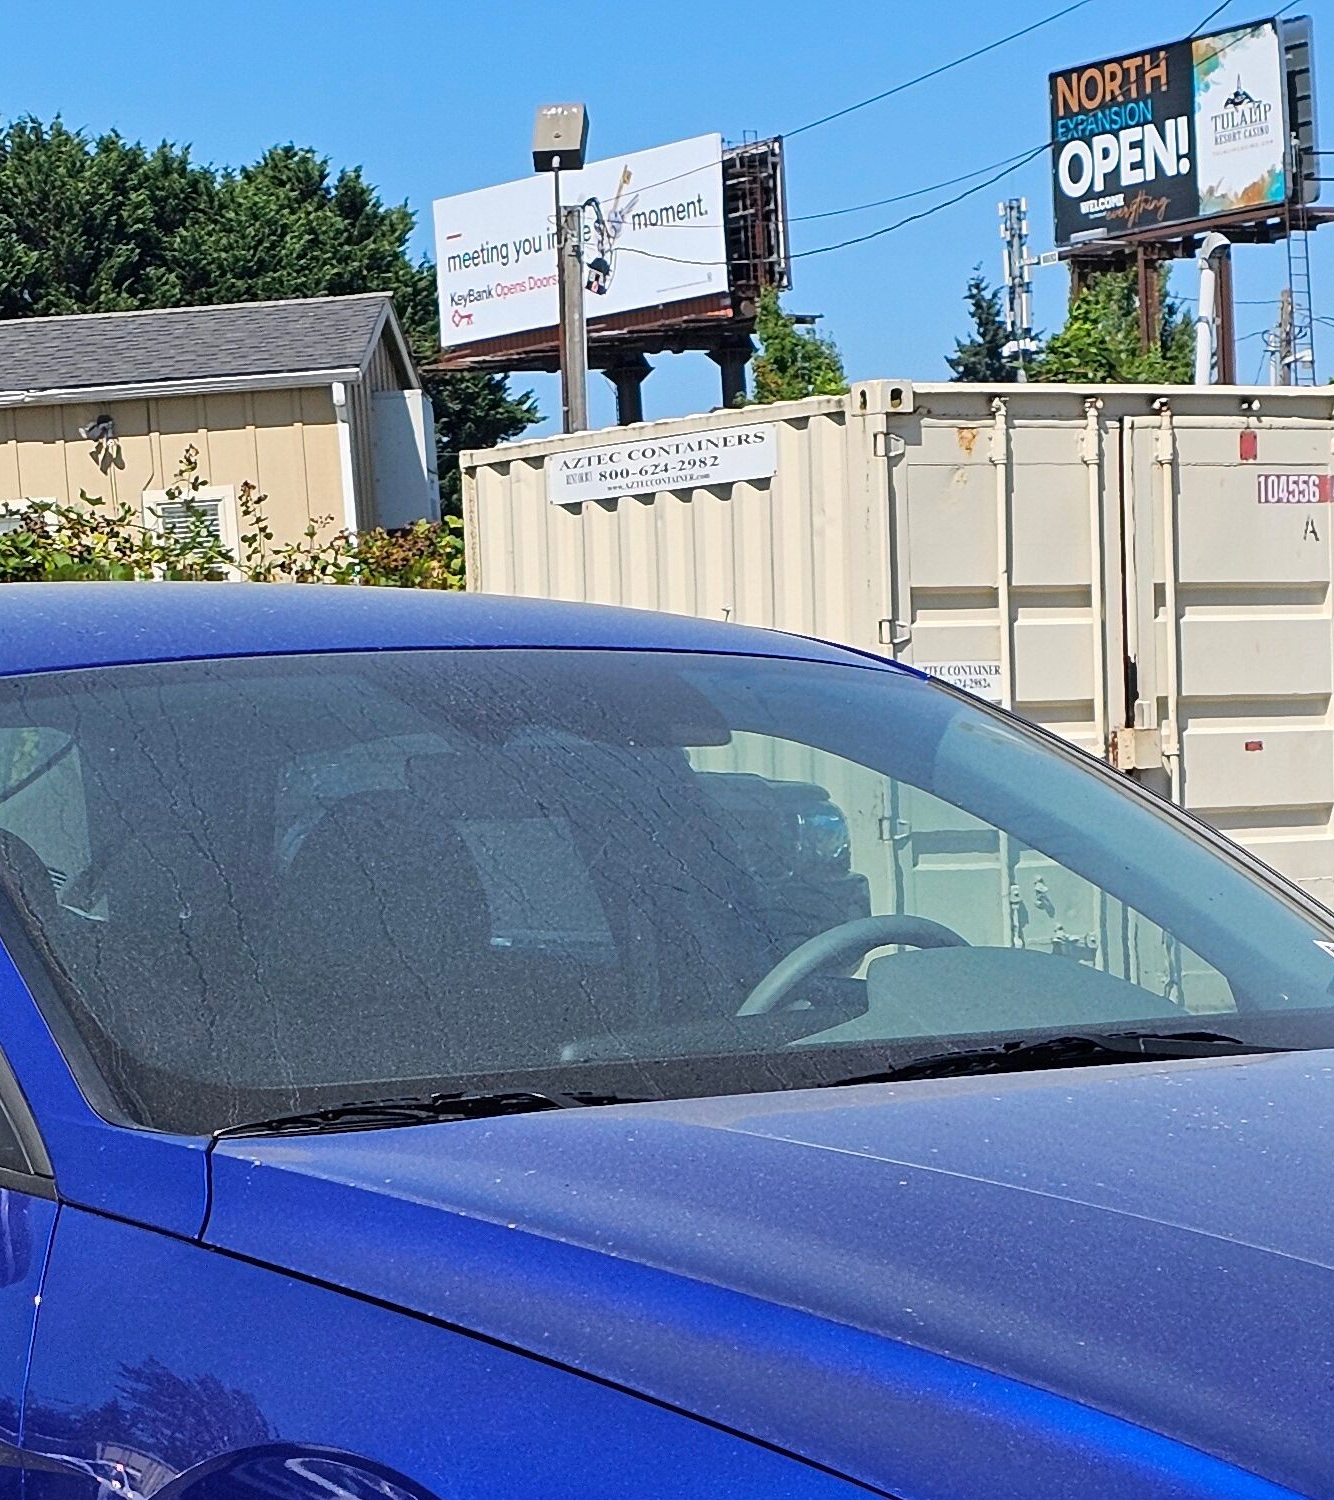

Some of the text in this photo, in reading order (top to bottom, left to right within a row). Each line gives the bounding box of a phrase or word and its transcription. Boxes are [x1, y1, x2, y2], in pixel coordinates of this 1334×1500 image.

[1056, 51, 1167, 117] NORTH
[1057, 98, 1153, 141] EXPANSION
[1210, 103, 1272, 132] TULALIP
[1214, 124, 1270, 146] RESORT CASINO
[1058, 115, 1191, 198] OPEN!
[631, 193, 709, 231] moment.
[1080, 193, 1125, 215] WELCOME
[447, 241, 510, 273] meeting
[513, 235, 543, 263] you
[450, 284, 495, 308] KeyBank
[495, 280, 527, 299] Opens
[559, 431, 766, 472] AZTEC CONTAINERS
[598, 455, 720, 482] 800-624-2982
[1258, 475, 1320, 503] 104556
[1303, 514, 1320, 542] A
[947, 664, 1002, 676] CONTAINER
